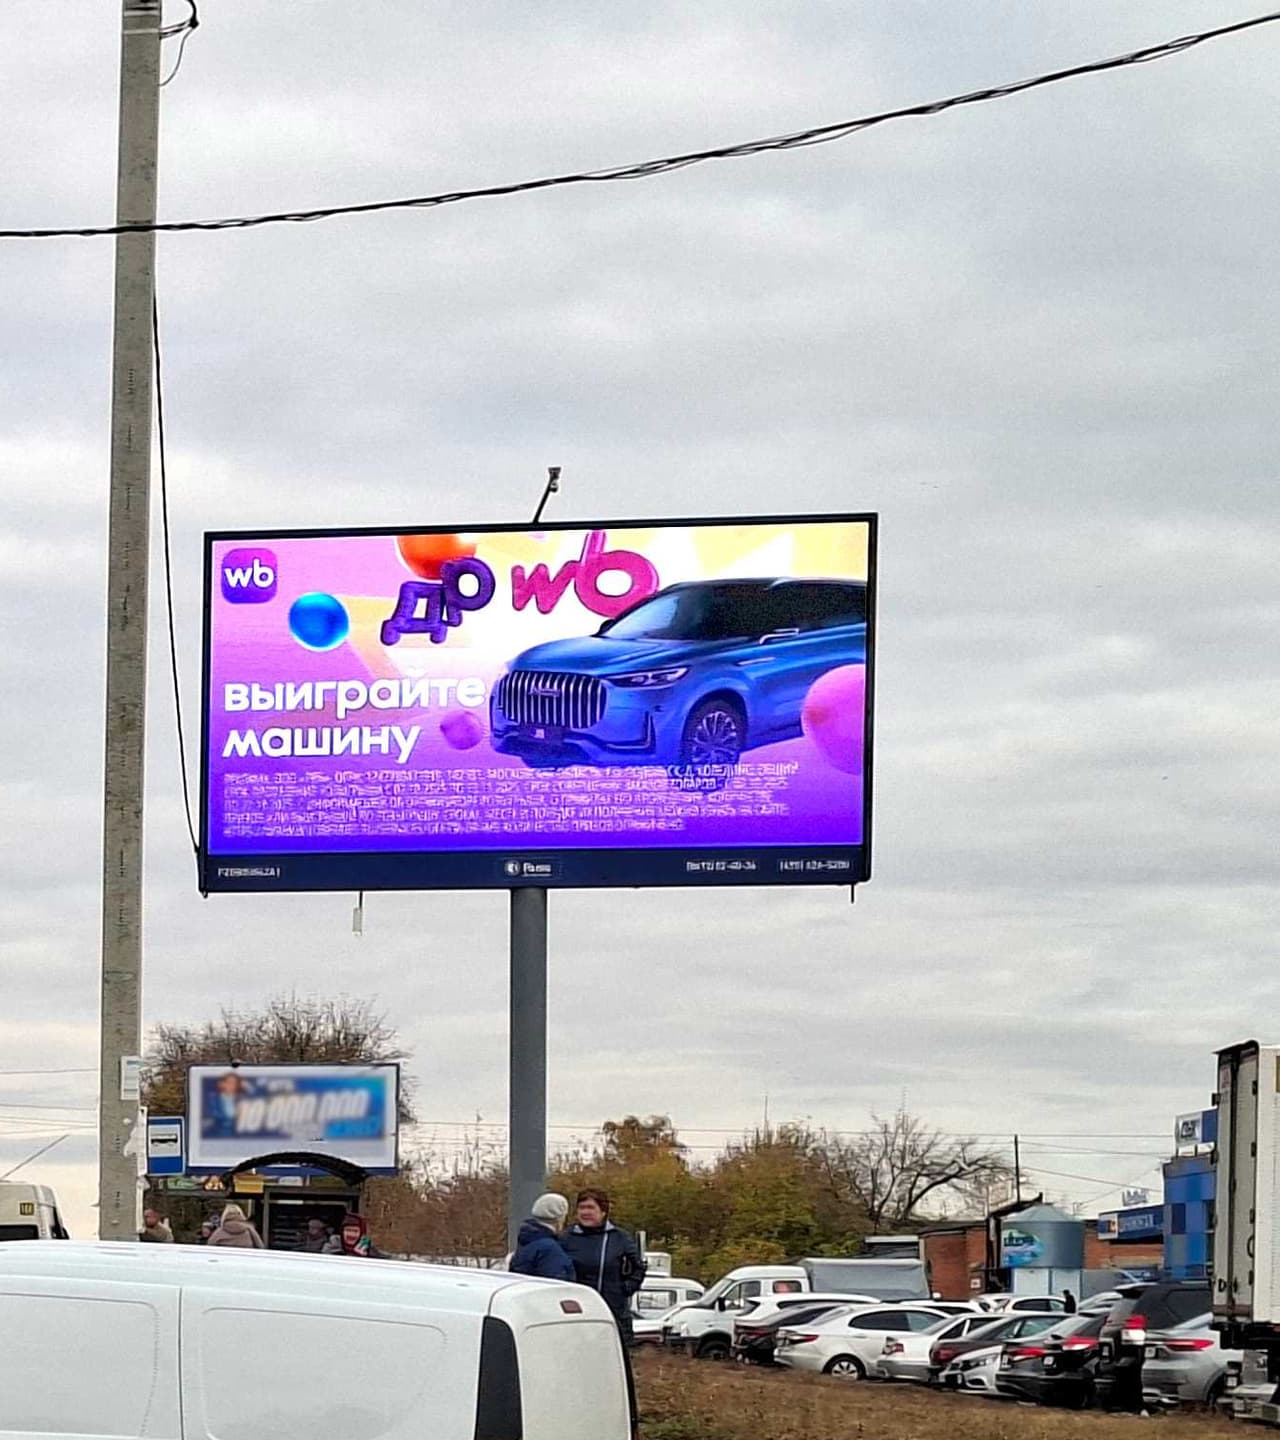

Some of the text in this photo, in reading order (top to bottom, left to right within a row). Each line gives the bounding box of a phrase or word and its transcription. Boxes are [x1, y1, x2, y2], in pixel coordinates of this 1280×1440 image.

[224, 558, 275, 588] wb
[511, 529, 659, 619] wb
[224, 669, 487, 720] выиграйте
[222, 725, 422, 764] машину
